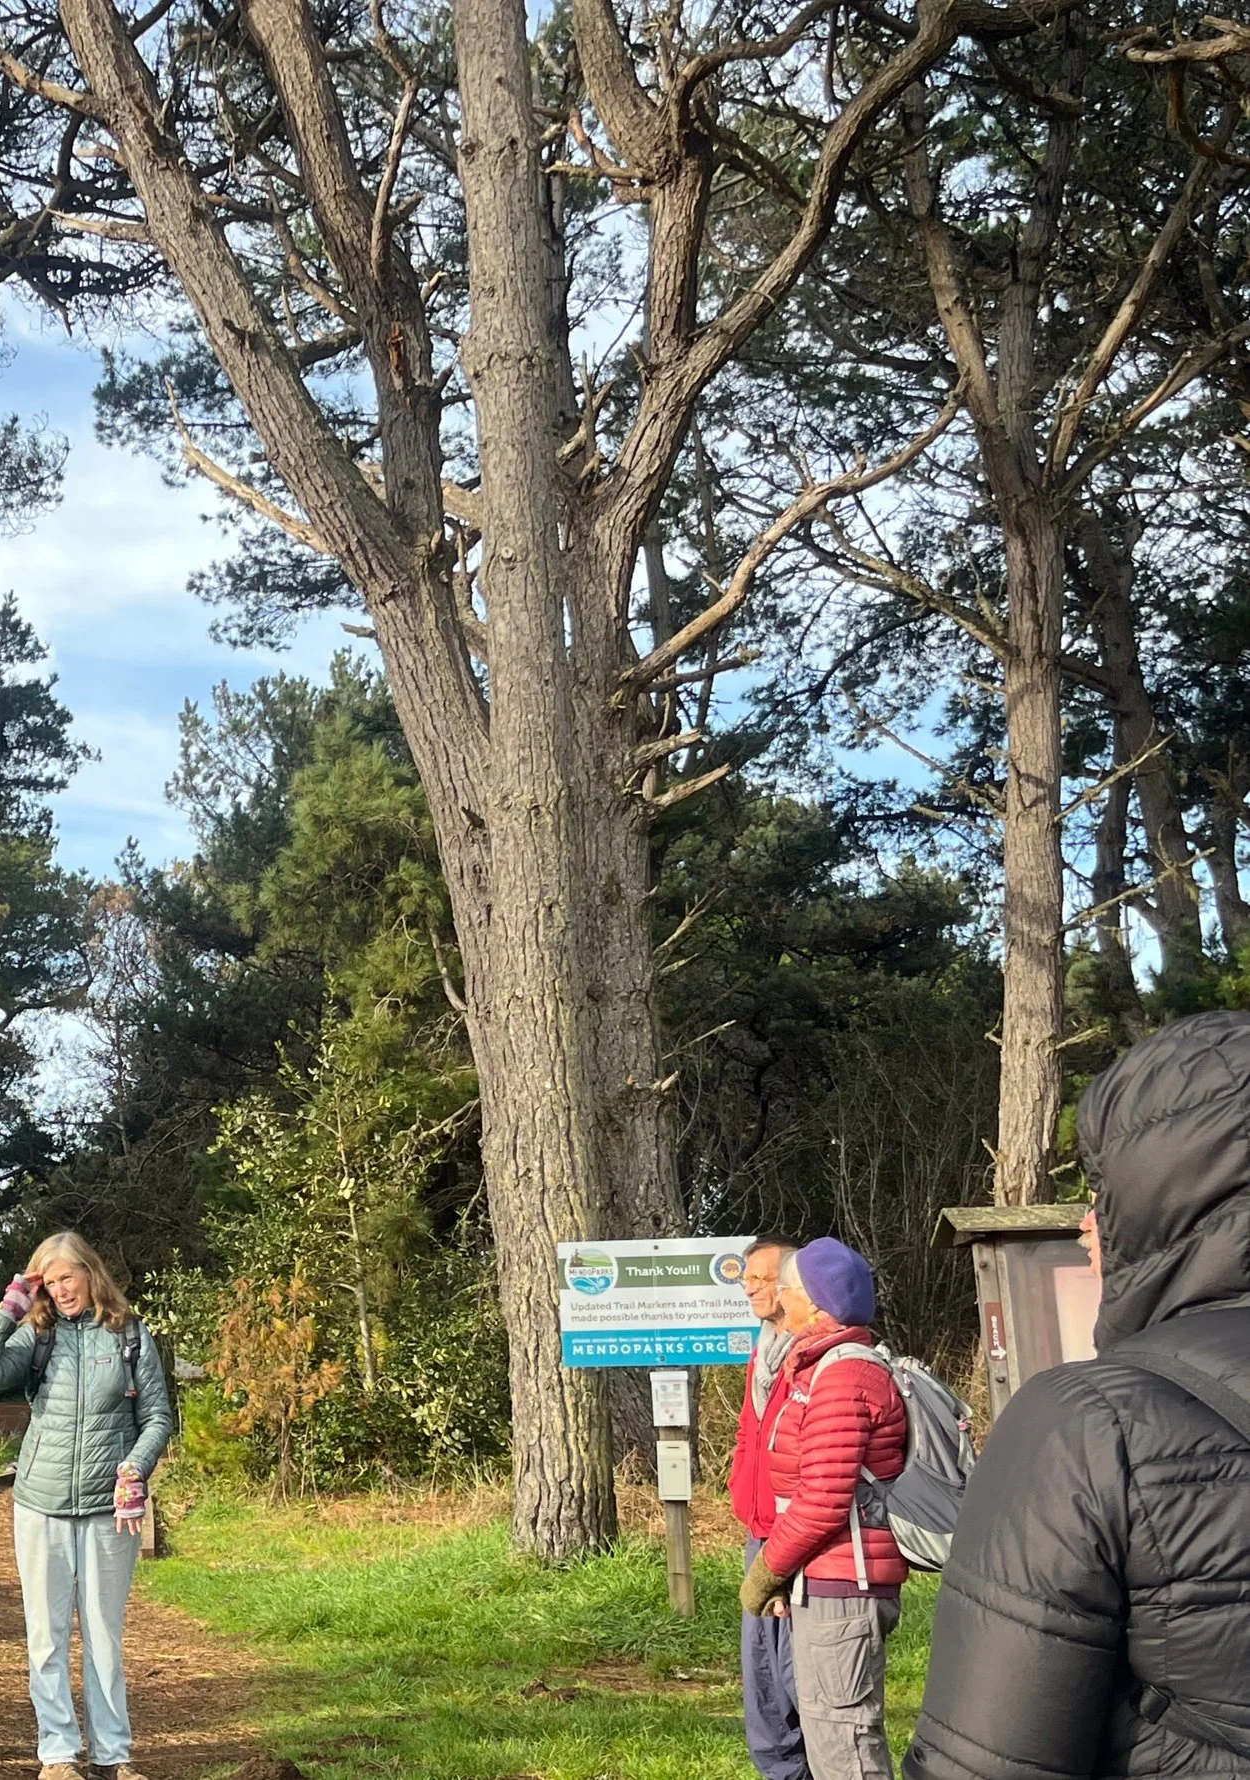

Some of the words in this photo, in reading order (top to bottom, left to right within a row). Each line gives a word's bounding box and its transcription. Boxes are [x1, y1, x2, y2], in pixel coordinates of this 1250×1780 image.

[625, 1266, 664, 1276] Thank
[665, 1265, 700, 1275] You!!!
[571, 1302, 612, 1312] Updated
[613, 1301, 635, 1310] Trail
[637, 1300, 676, 1309] Markers
[678, 1299, 697, 1308] and
[699, 1299, 721, 1308] Trail
[724, 1299, 749, 1308] Maps
[571, 1313, 598, 1322] made
[600, 1313, 639, 1322] possible
[640, 1311, 673, 1321] thanks
[687, 1312, 710, 1322] your
[712, 1311, 750, 1320] support
[991, 1316, 999, 1347] BEACH
[572, 1343, 727, 1355] MENDOPARKS.ORG
